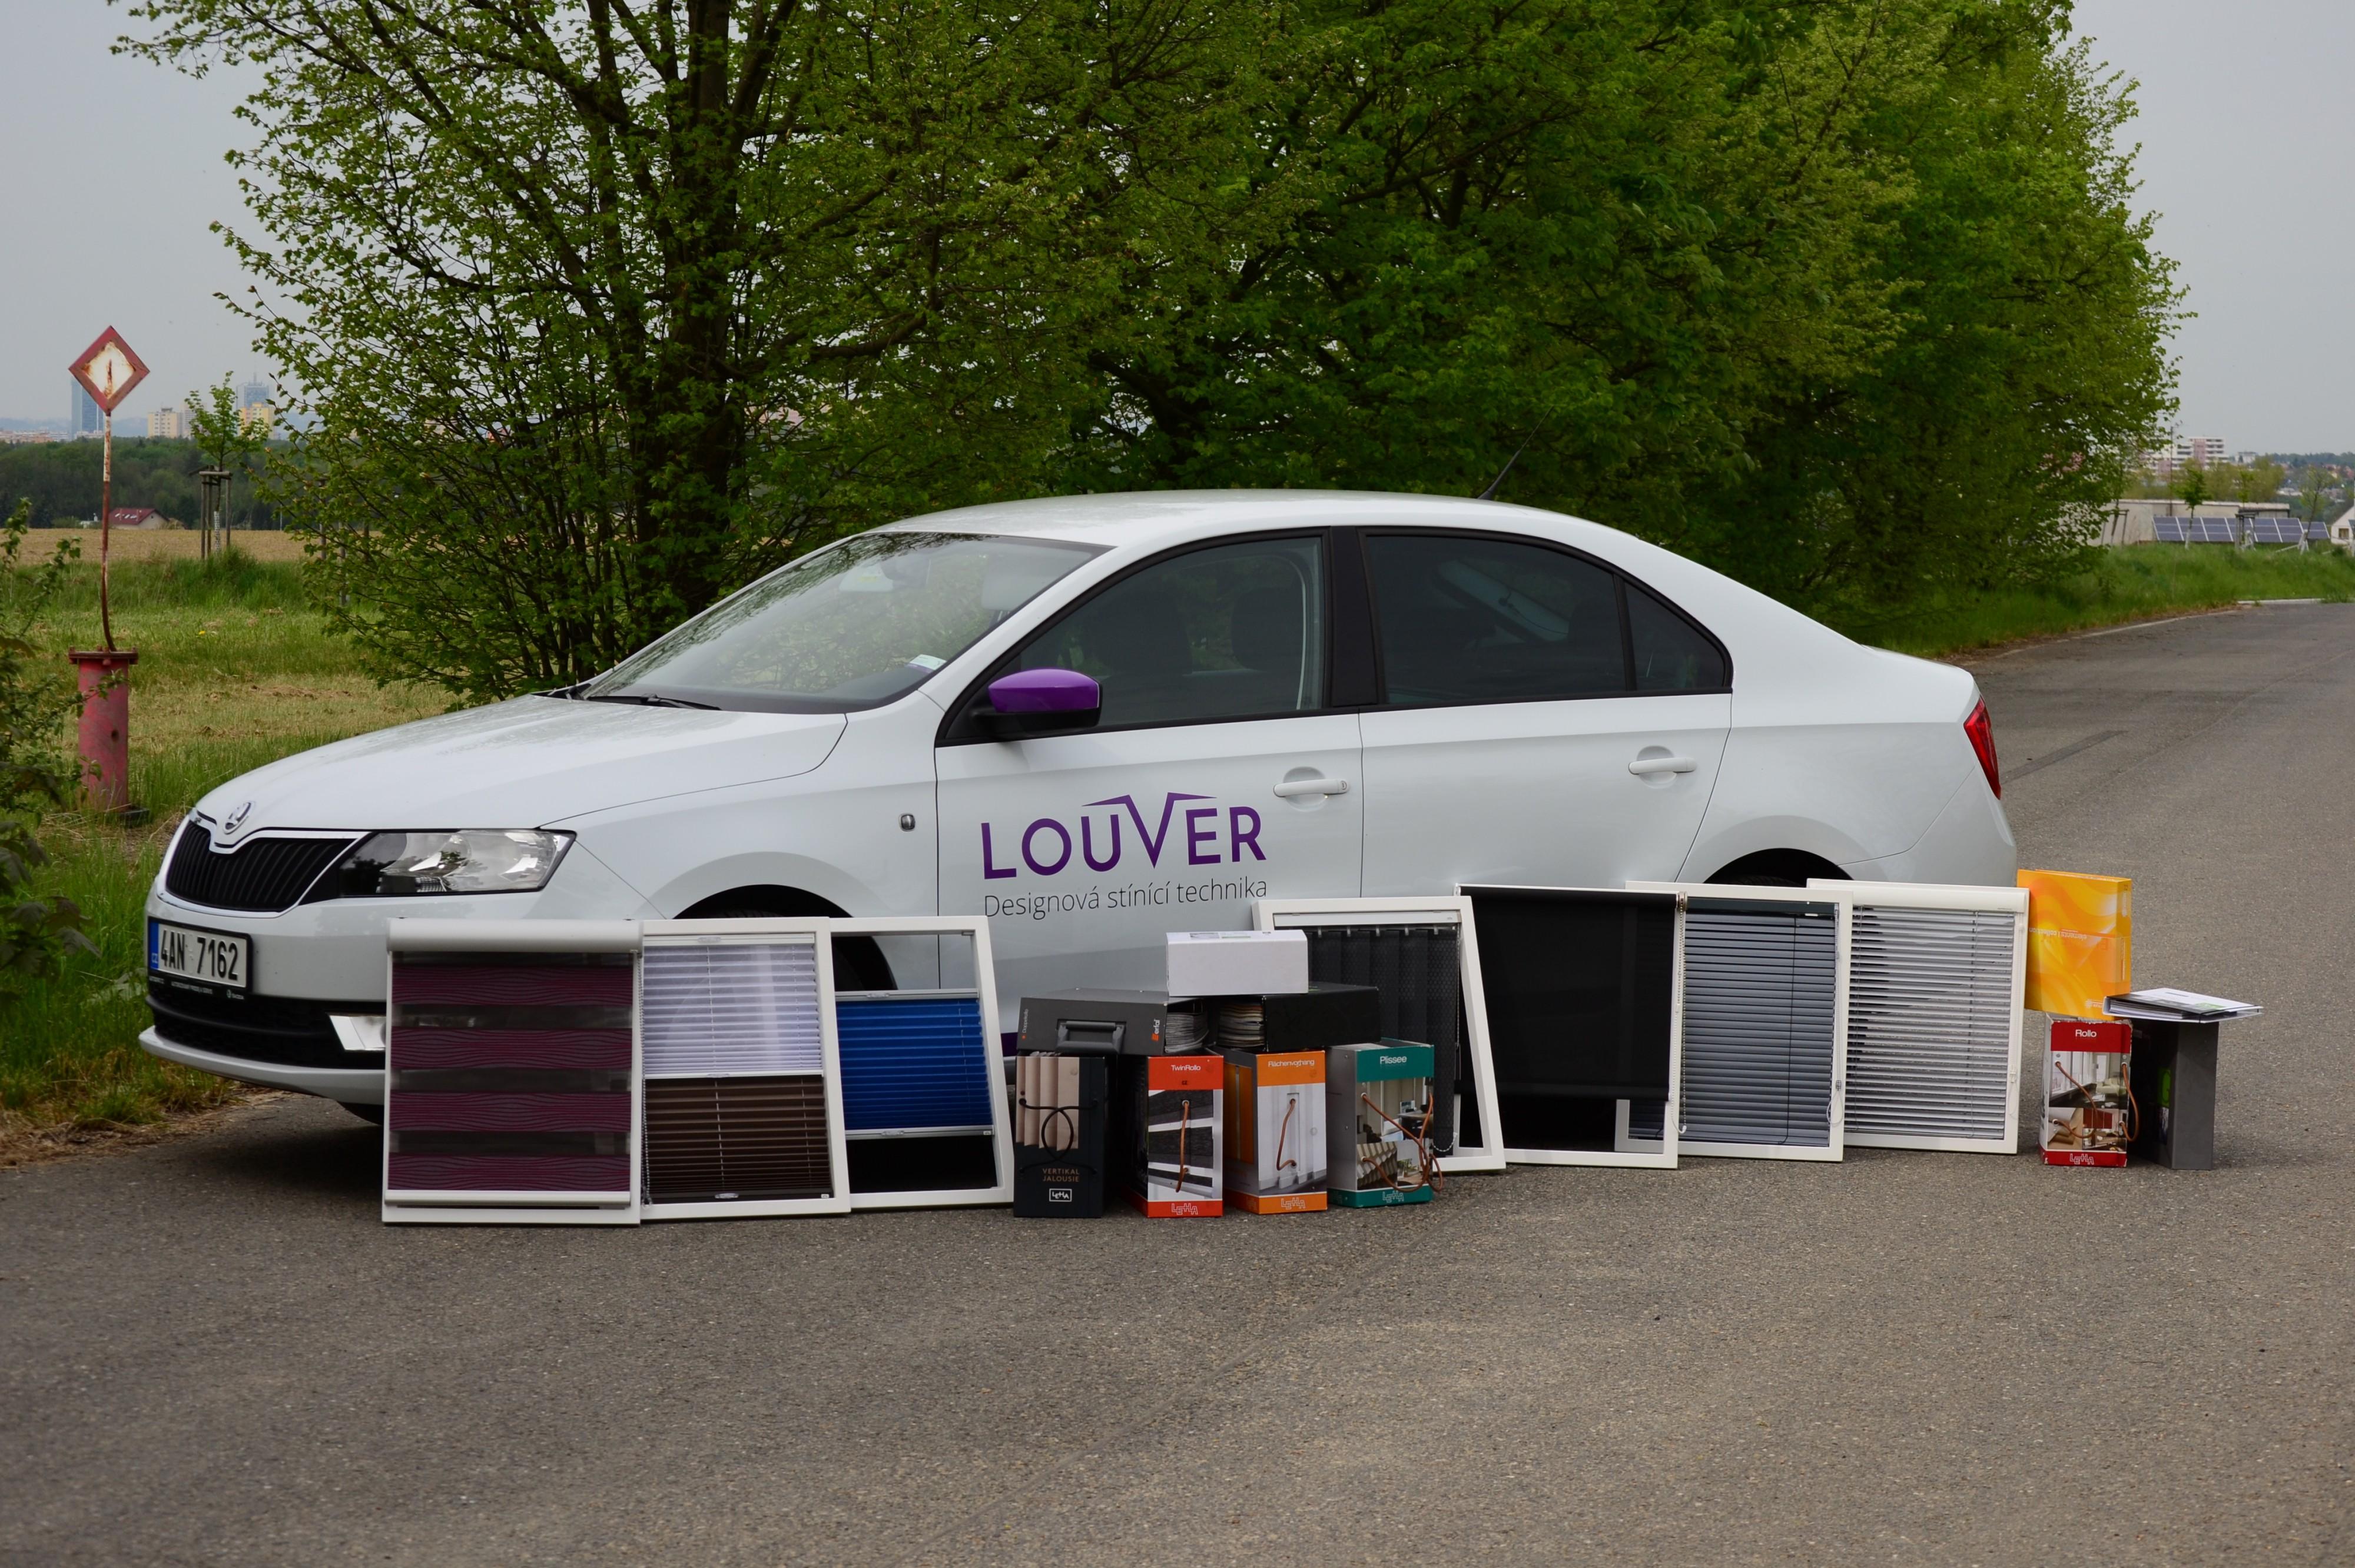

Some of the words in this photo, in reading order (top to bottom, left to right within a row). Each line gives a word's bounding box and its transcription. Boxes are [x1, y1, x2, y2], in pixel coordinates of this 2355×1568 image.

[981, 792, 1266, 879] LOUVER
[984, 886, 1100, 920] Designová
[1107, 881, 1170, 908] stínící
[1176, 876, 1267, 903] technika
[161, 929, 185, 971] 4AN
[197, 935, 238, 981] 7162
[2075, 1029, 2097, 1037] Rollo
[1379, 1055, 1407, 1064] Plissee
